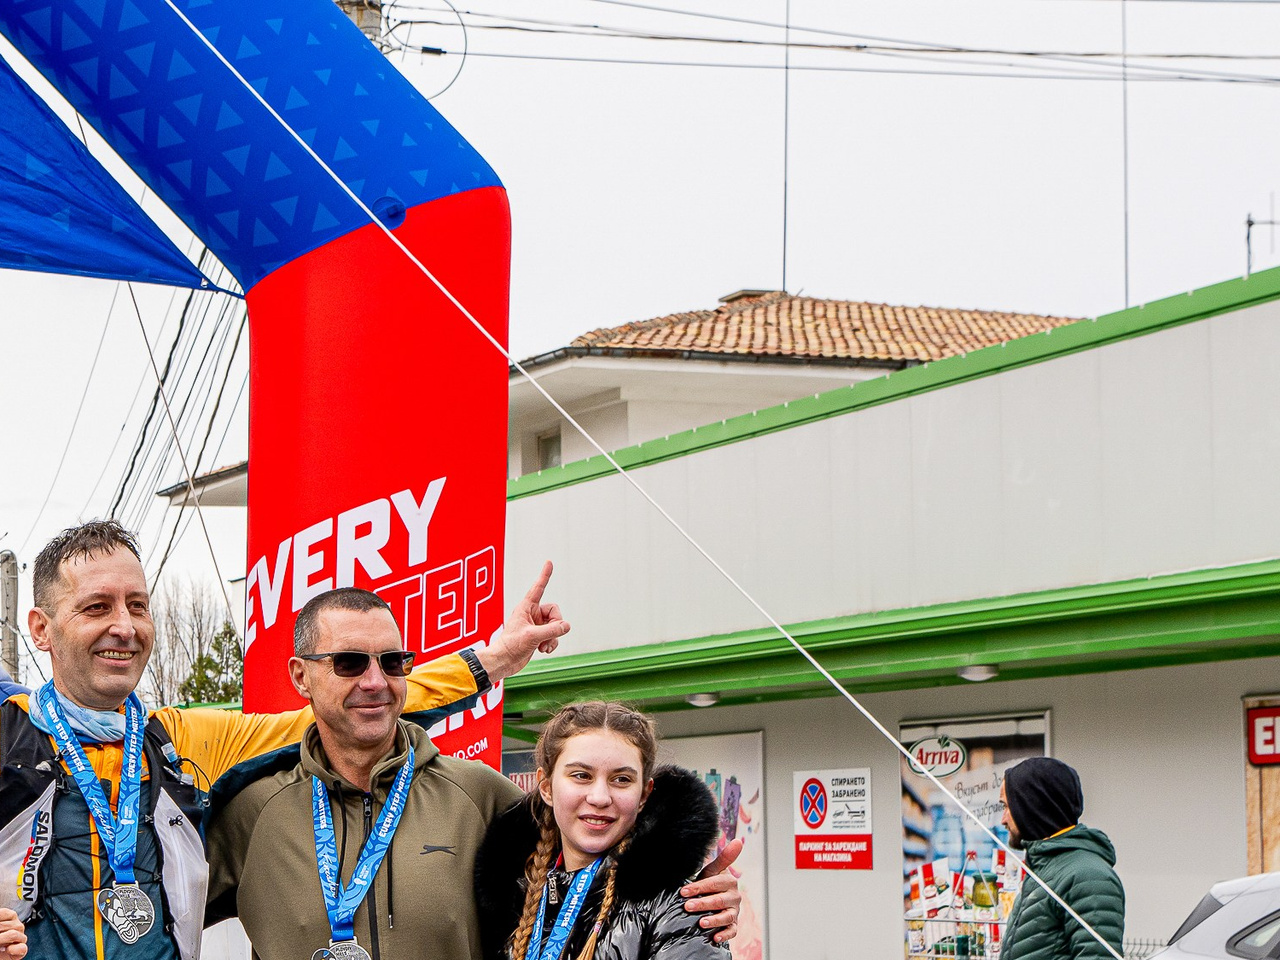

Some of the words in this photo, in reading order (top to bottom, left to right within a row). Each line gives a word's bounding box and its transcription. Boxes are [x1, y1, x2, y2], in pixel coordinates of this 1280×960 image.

[245, 477, 447, 656] EVERY
[370, 545, 496, 654] TEP
[46, 702, 60, 724] EVERY
[55, 721, 68, 742] STEP
[65, 739, 85, 772] MATTERS
[129, 731, 137, 753] STEP
[127, 753, 136, 778] EVERY
[914, 748, 960, 766] Arriva
[831, 777, 865, 786] СПИРАНЕТО
[832, 789, 865, 798] ЗАБРАНЕНО
[318, 797, 327, 829] MATTERS
[378, 814, 394, 838] EVERY
[390, 792, 401, 813] STEP
[22, 811, 50, 902] SALOMON
[799, 842, 824, 851] ПАРКИНГ
[824, 842, 832, 851] ЗА
[576, 873, 588, 893] STEP
[561, 894, 579, 927] MATTERS
